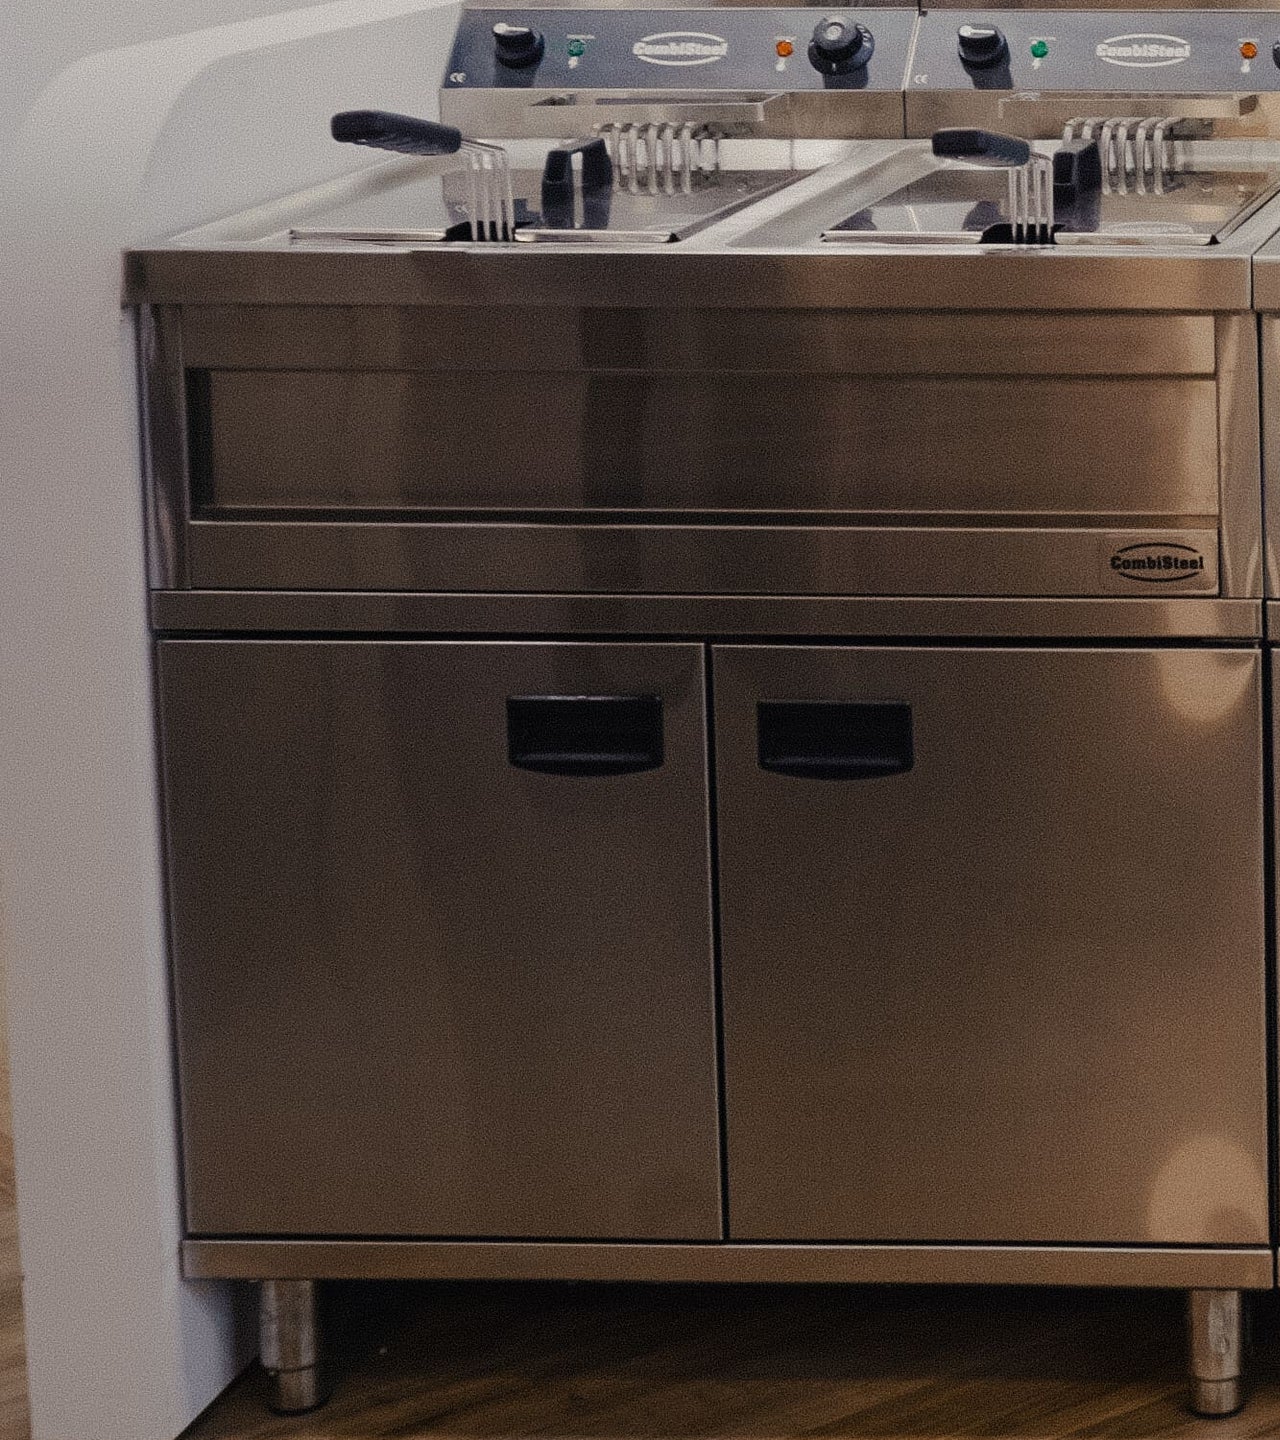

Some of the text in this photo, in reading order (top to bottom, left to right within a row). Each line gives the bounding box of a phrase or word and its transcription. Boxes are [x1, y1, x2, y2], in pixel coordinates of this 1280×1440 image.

[632, 42, 728, 56] CombiSteel
[1095, 44, 1191, 58] CombiSteel
[1110, 555, 1203, 570] CombiSteel
